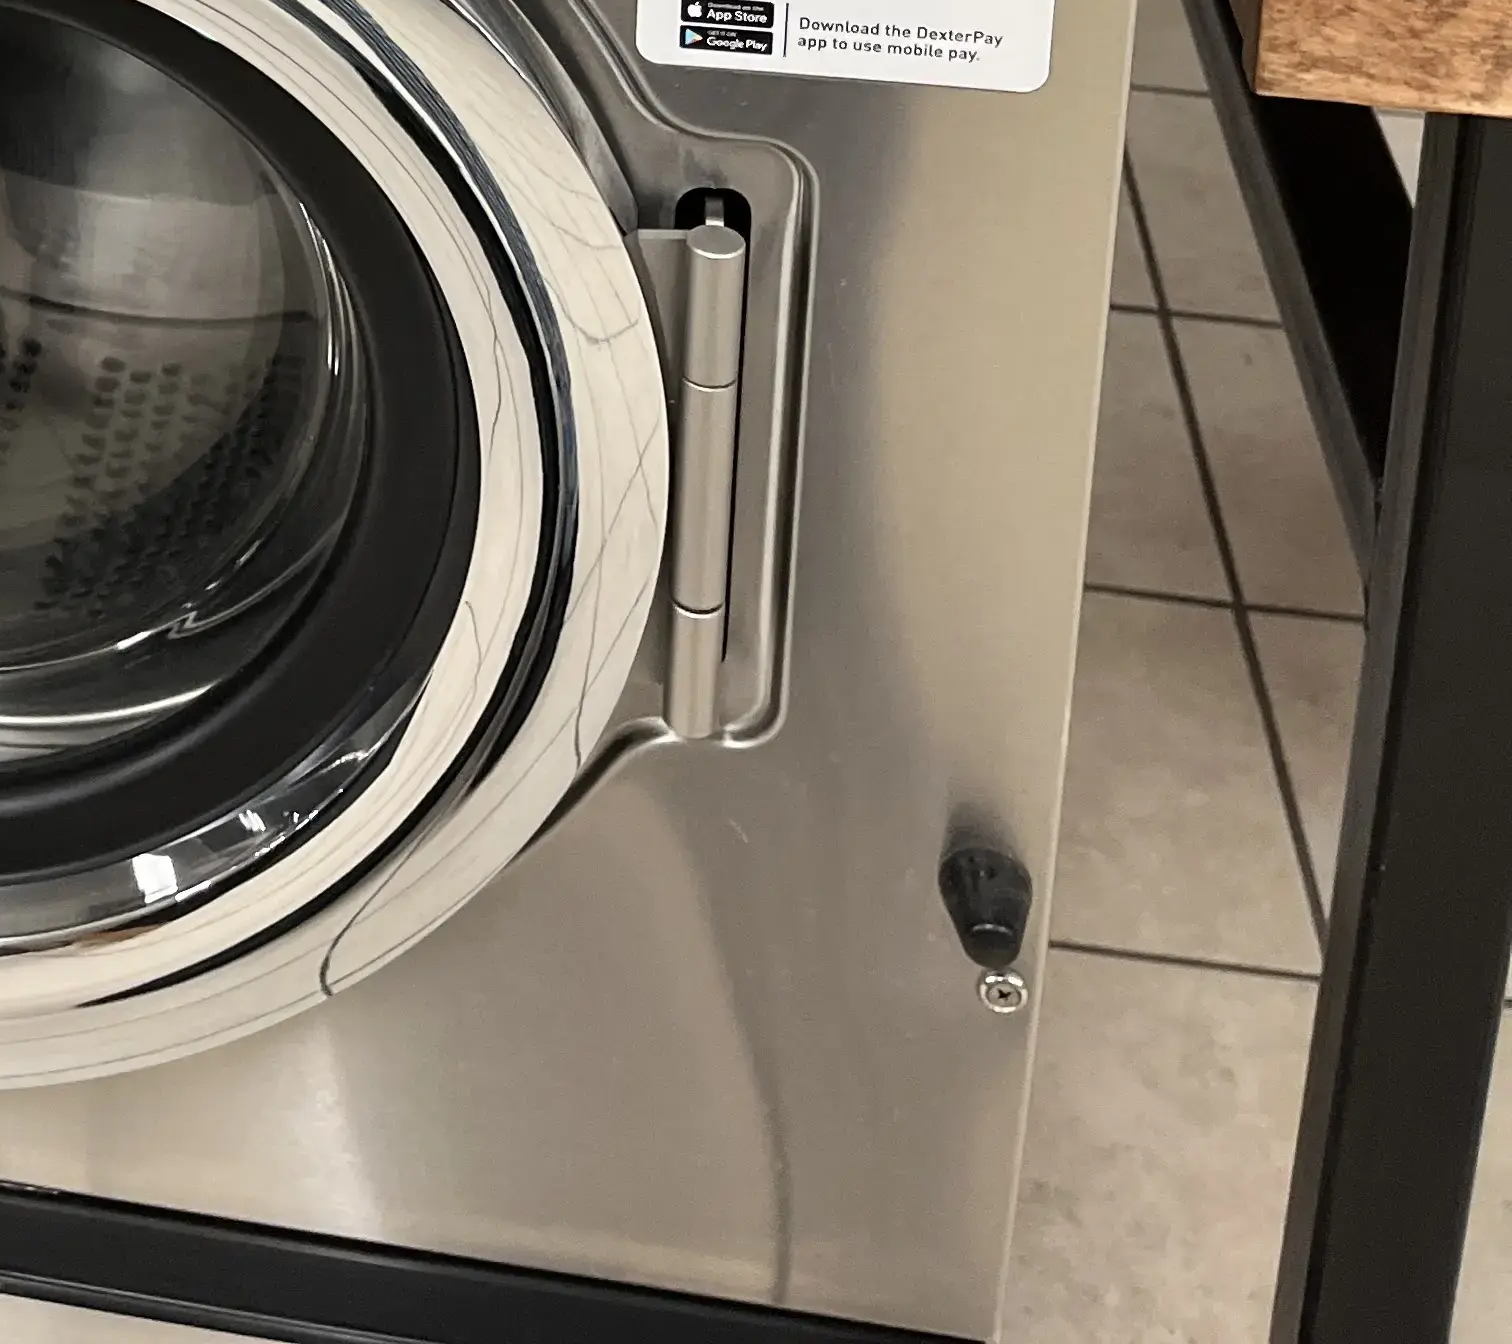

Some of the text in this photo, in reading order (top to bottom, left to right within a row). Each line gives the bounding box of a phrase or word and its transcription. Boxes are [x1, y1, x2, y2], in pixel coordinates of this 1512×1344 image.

[706, 7, 731, 23] App
[734, 10, 767, 24] Store
[799, 17, 1003, 48] Download the DexterPay
[706, 36, 767, 52] Google Play
[798, 35, 980, 63] app to use mobile pay.
